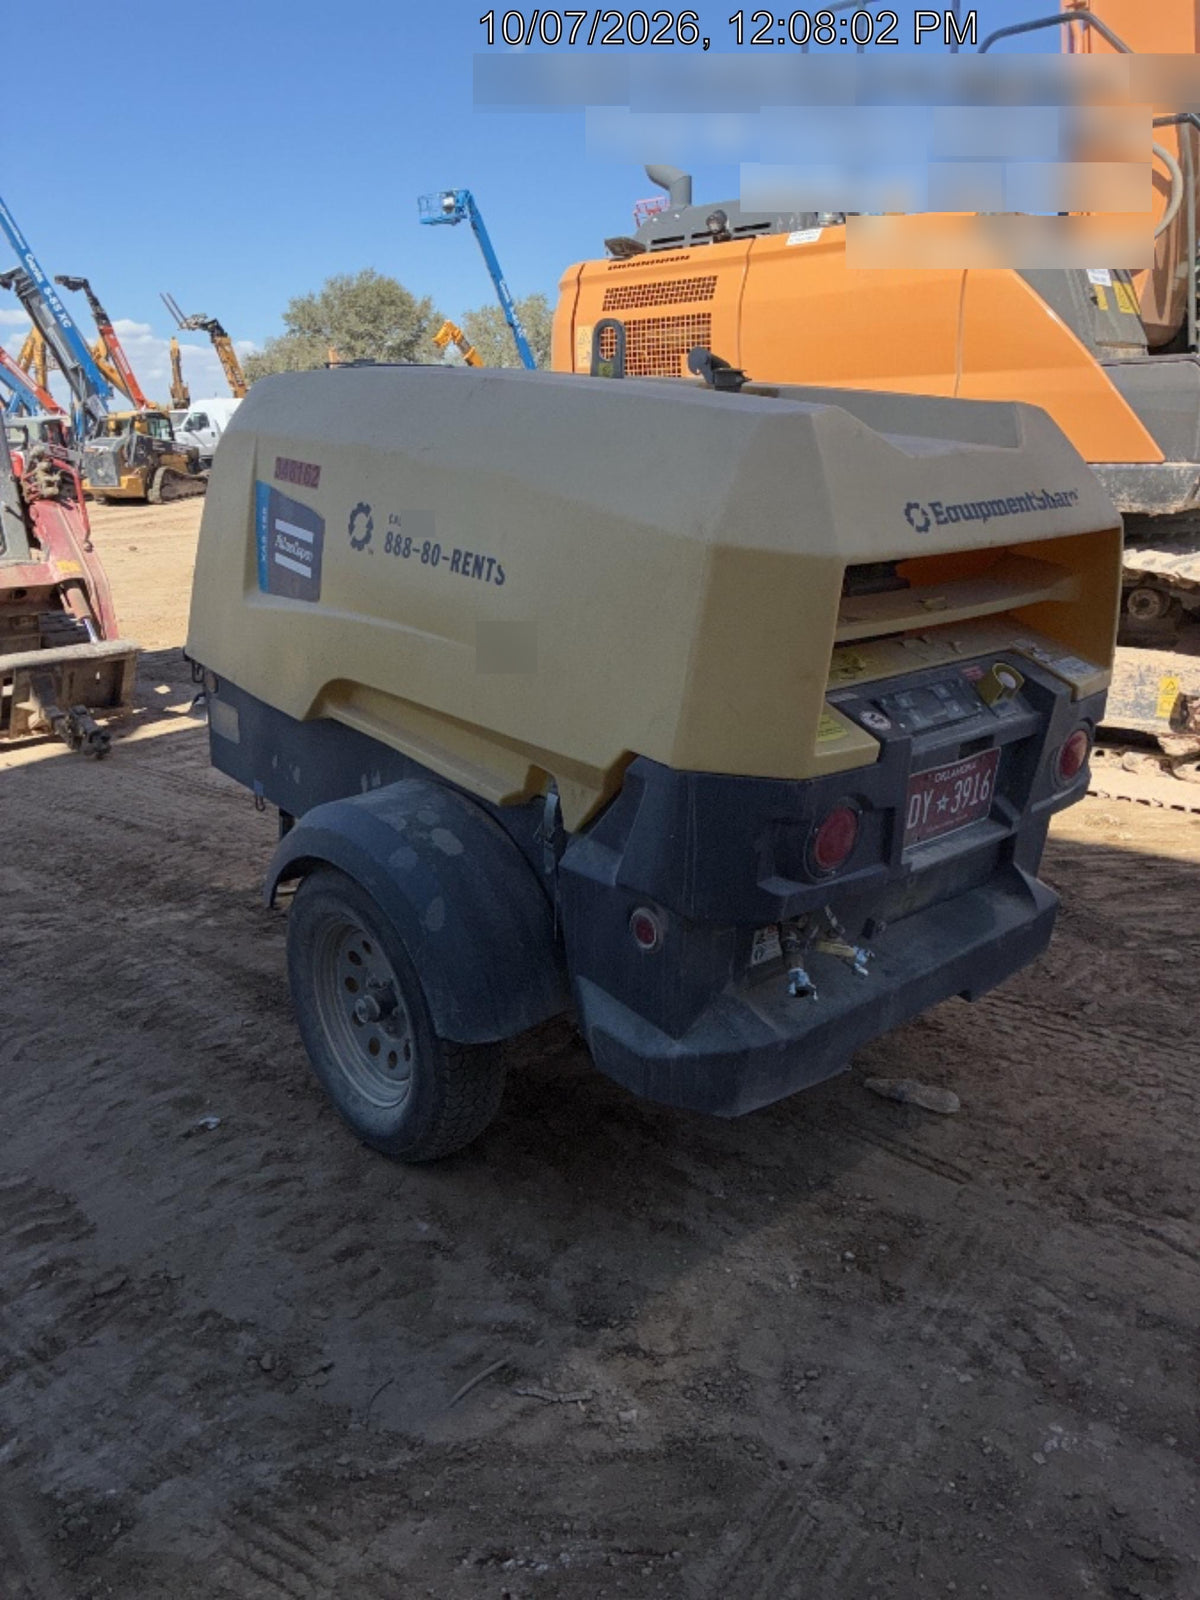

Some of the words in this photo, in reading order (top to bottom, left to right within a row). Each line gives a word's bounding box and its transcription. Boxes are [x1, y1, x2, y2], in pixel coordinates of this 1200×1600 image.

[384, 531, 506, 586] 888-80-RENTS
[906, 788, 935, 830] DY
[949, 769, 992, 814] 3916
